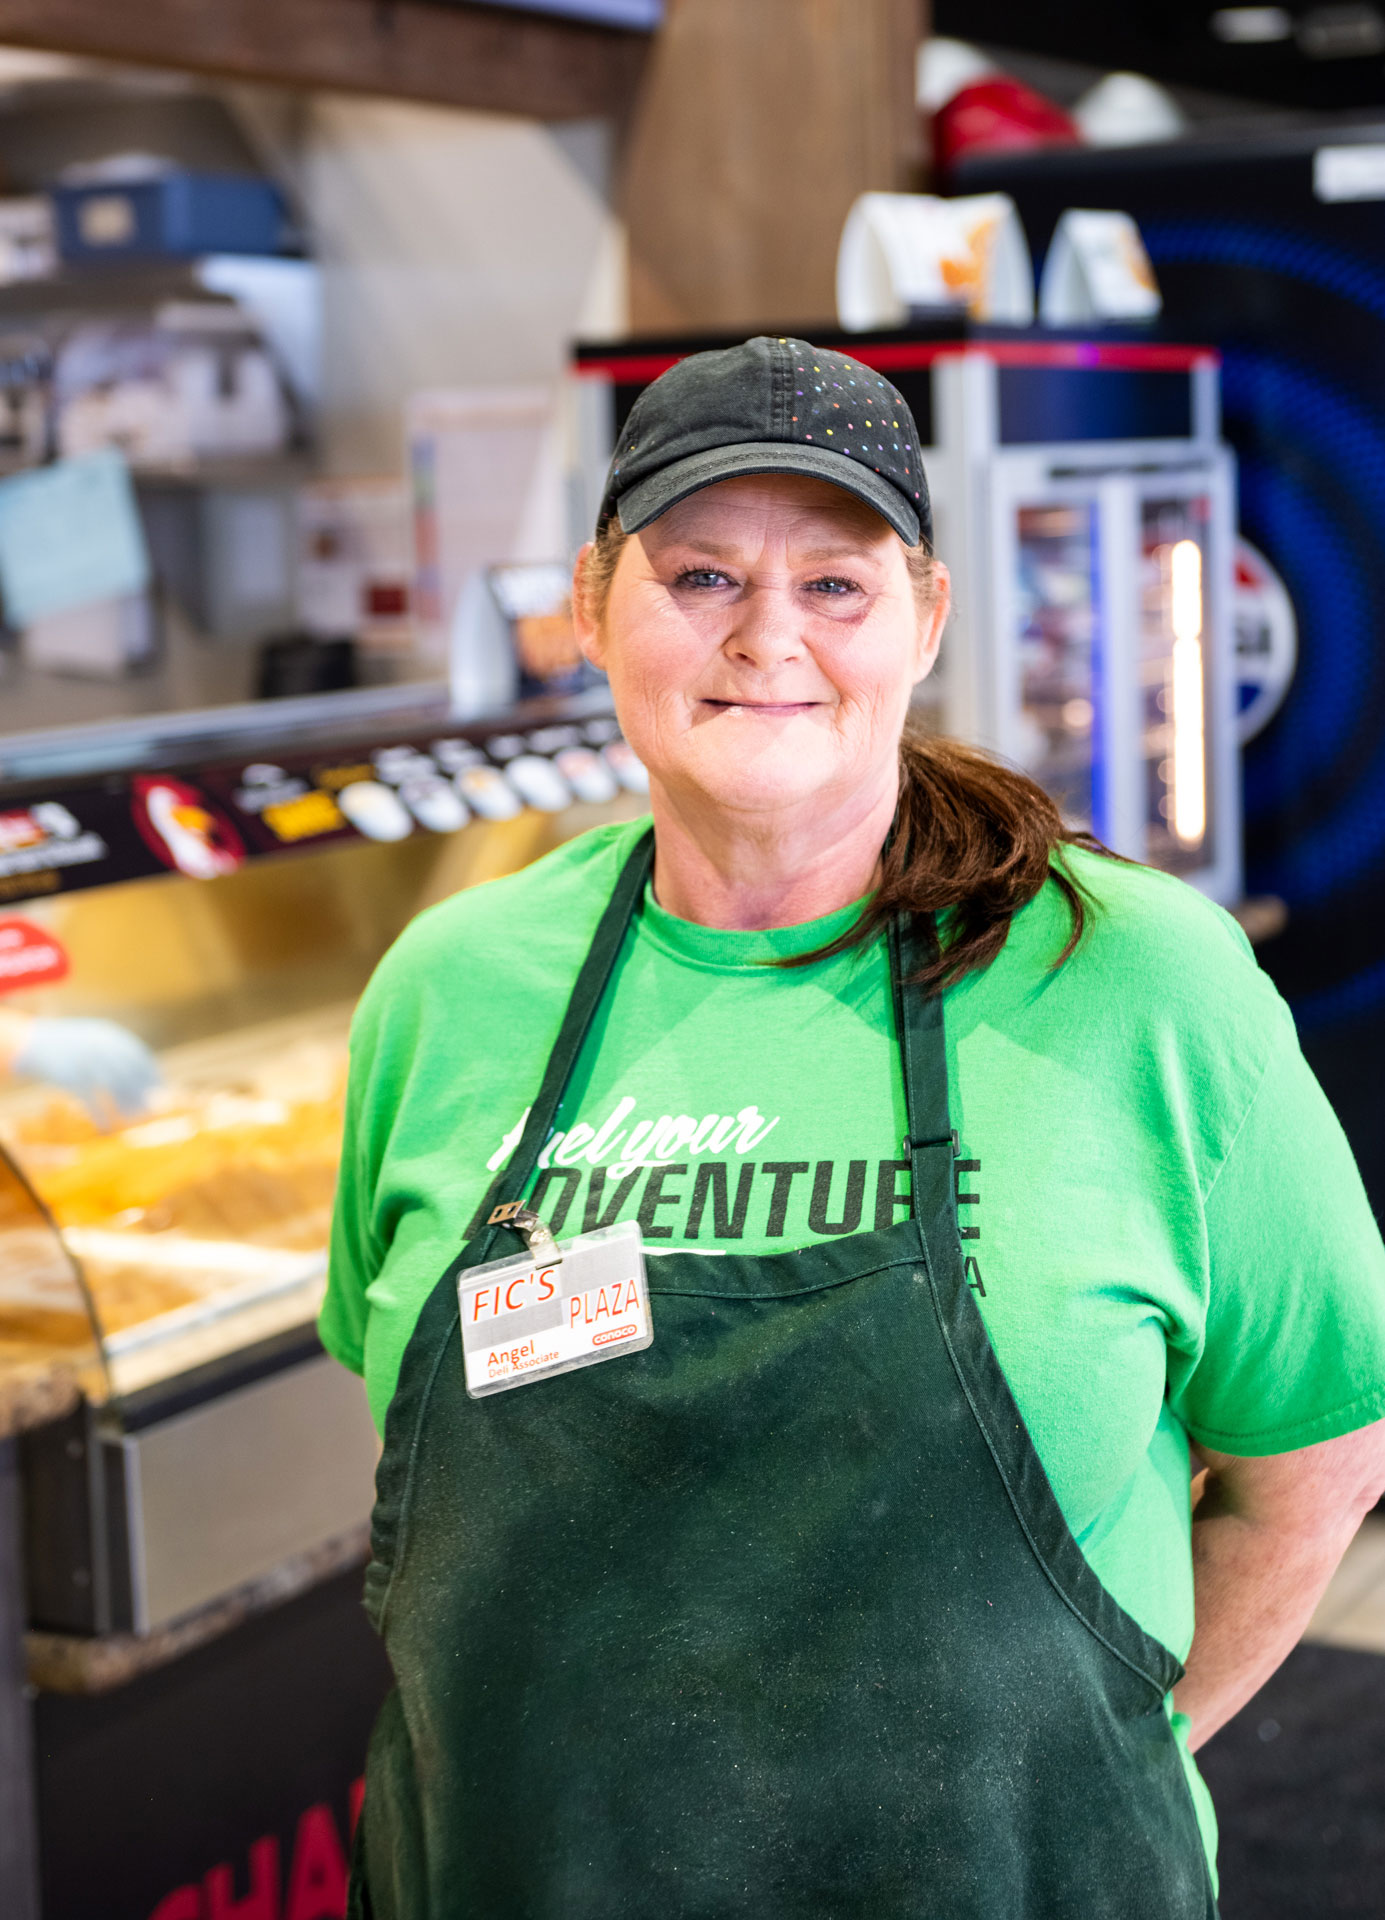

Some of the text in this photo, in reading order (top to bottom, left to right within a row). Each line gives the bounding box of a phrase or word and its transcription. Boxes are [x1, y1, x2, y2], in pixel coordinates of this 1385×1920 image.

[605, 1105, 780, 1180] your
[461, 1160, 981, 1240] DVENTURE
[473, 1270, 640, 1329] FIC'S PLAZA
[487, 1339, 535, 1369] Angel
[593, 1326, 636, 1344] conoco
[488, 1351, 559, 1378] Deli Associate
